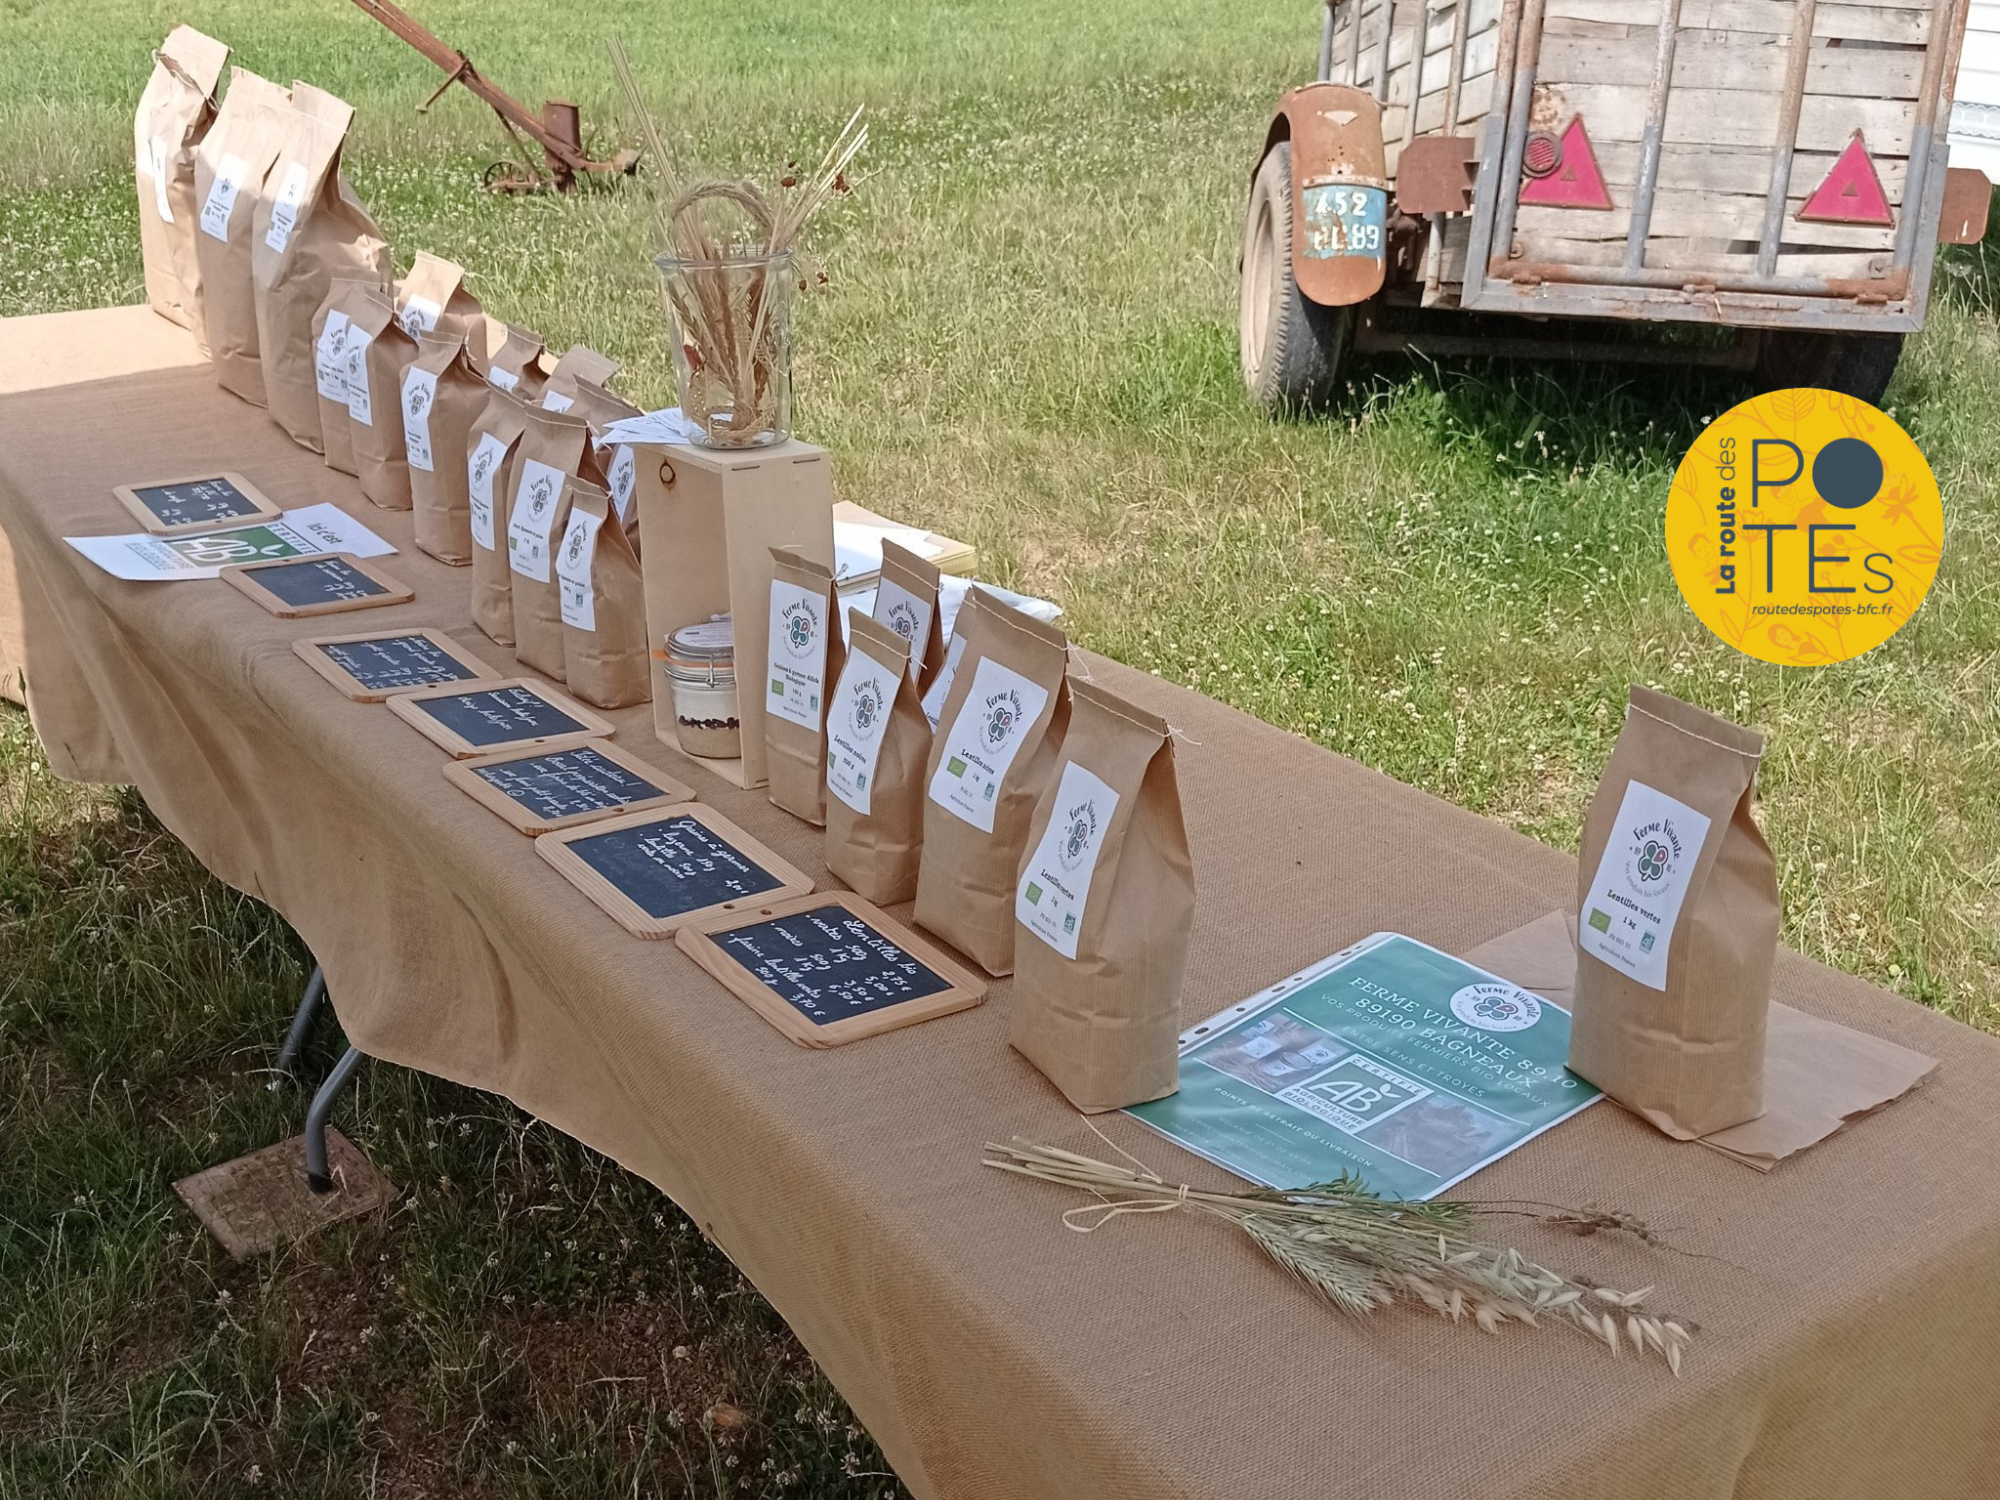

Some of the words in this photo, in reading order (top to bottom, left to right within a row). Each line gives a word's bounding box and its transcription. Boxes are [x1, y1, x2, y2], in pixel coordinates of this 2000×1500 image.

[782, 601, 801, 619] Ferme
[888, 604, 904, 619] Ferme
[853, 681, 872, 696] Ferme
[985, 692, 1008, 709] Ferme
[1010, 689, 1023, 723] Vivante
[961, 748, 983, 768] Lentilles
[1069, 802, 1088, 822] Ferme
[1632, 822, 1661, 841] Ferme
[1663, 819, 1682, 860] Vivante
[1041, 868, 1060, 889] Lentilles
[1606, 889, 1639, 913] Lentilles
[1639, 907, 1662, 925] vertes
[1622, 916, 1628, 924] 1
[1628, 919, 1637, 930] kg
[811, 918, 843, 941] vertes
[843, 919, 898, 963] Lentilles
[898, 961, 916, 975] bio
[1473, 985, 1509, 995] Ferme
[1513, 991, 1539, 1018] Vivante
[1318, 992, 1347, 1009] VOS
[1343, 1006, 1408, 1039] PRODUITS
[1404, 1036, 1470, 1067] FERMIERS
[1469, 1065, 1496, 1080] BIO
[1495, 1080, 1551, 1107] LOCAUX
[1347, 975, 1421, 1013] FERME
[1418, 1008, 1517, 1059] VIVANTE
[1514, 1058, 1579, 1090] 89.10
[1352, 995, 1418, 1031] 89190
[1417, 1026, 1539, 1088] BAGNEAUX
[1340, 1024, 1383, 1048] ENTRE
[1381, 1045, 1418, 1065] SENS
[1415, 1062, 1436, 1074] ET
[1433, 1070, 1486, 1097] TROYES
[1349, 1057, 1425, 1095] CERTIFIÉ
[1280, 1090, 1358, 1130] BIOLOGIQUE
[1289, 1087, 1367, 1125] AGRICULTURE
[1303, 1069, 1390, 1115] AB
[1211, 1086, 1250, 1106] POINTS
[1262, 1111, 1304, 1132] RETRAIT
[1301, 1130, 1320, 1140] OU
[1317, 1138, 1375, 1167] LIVRAISON
